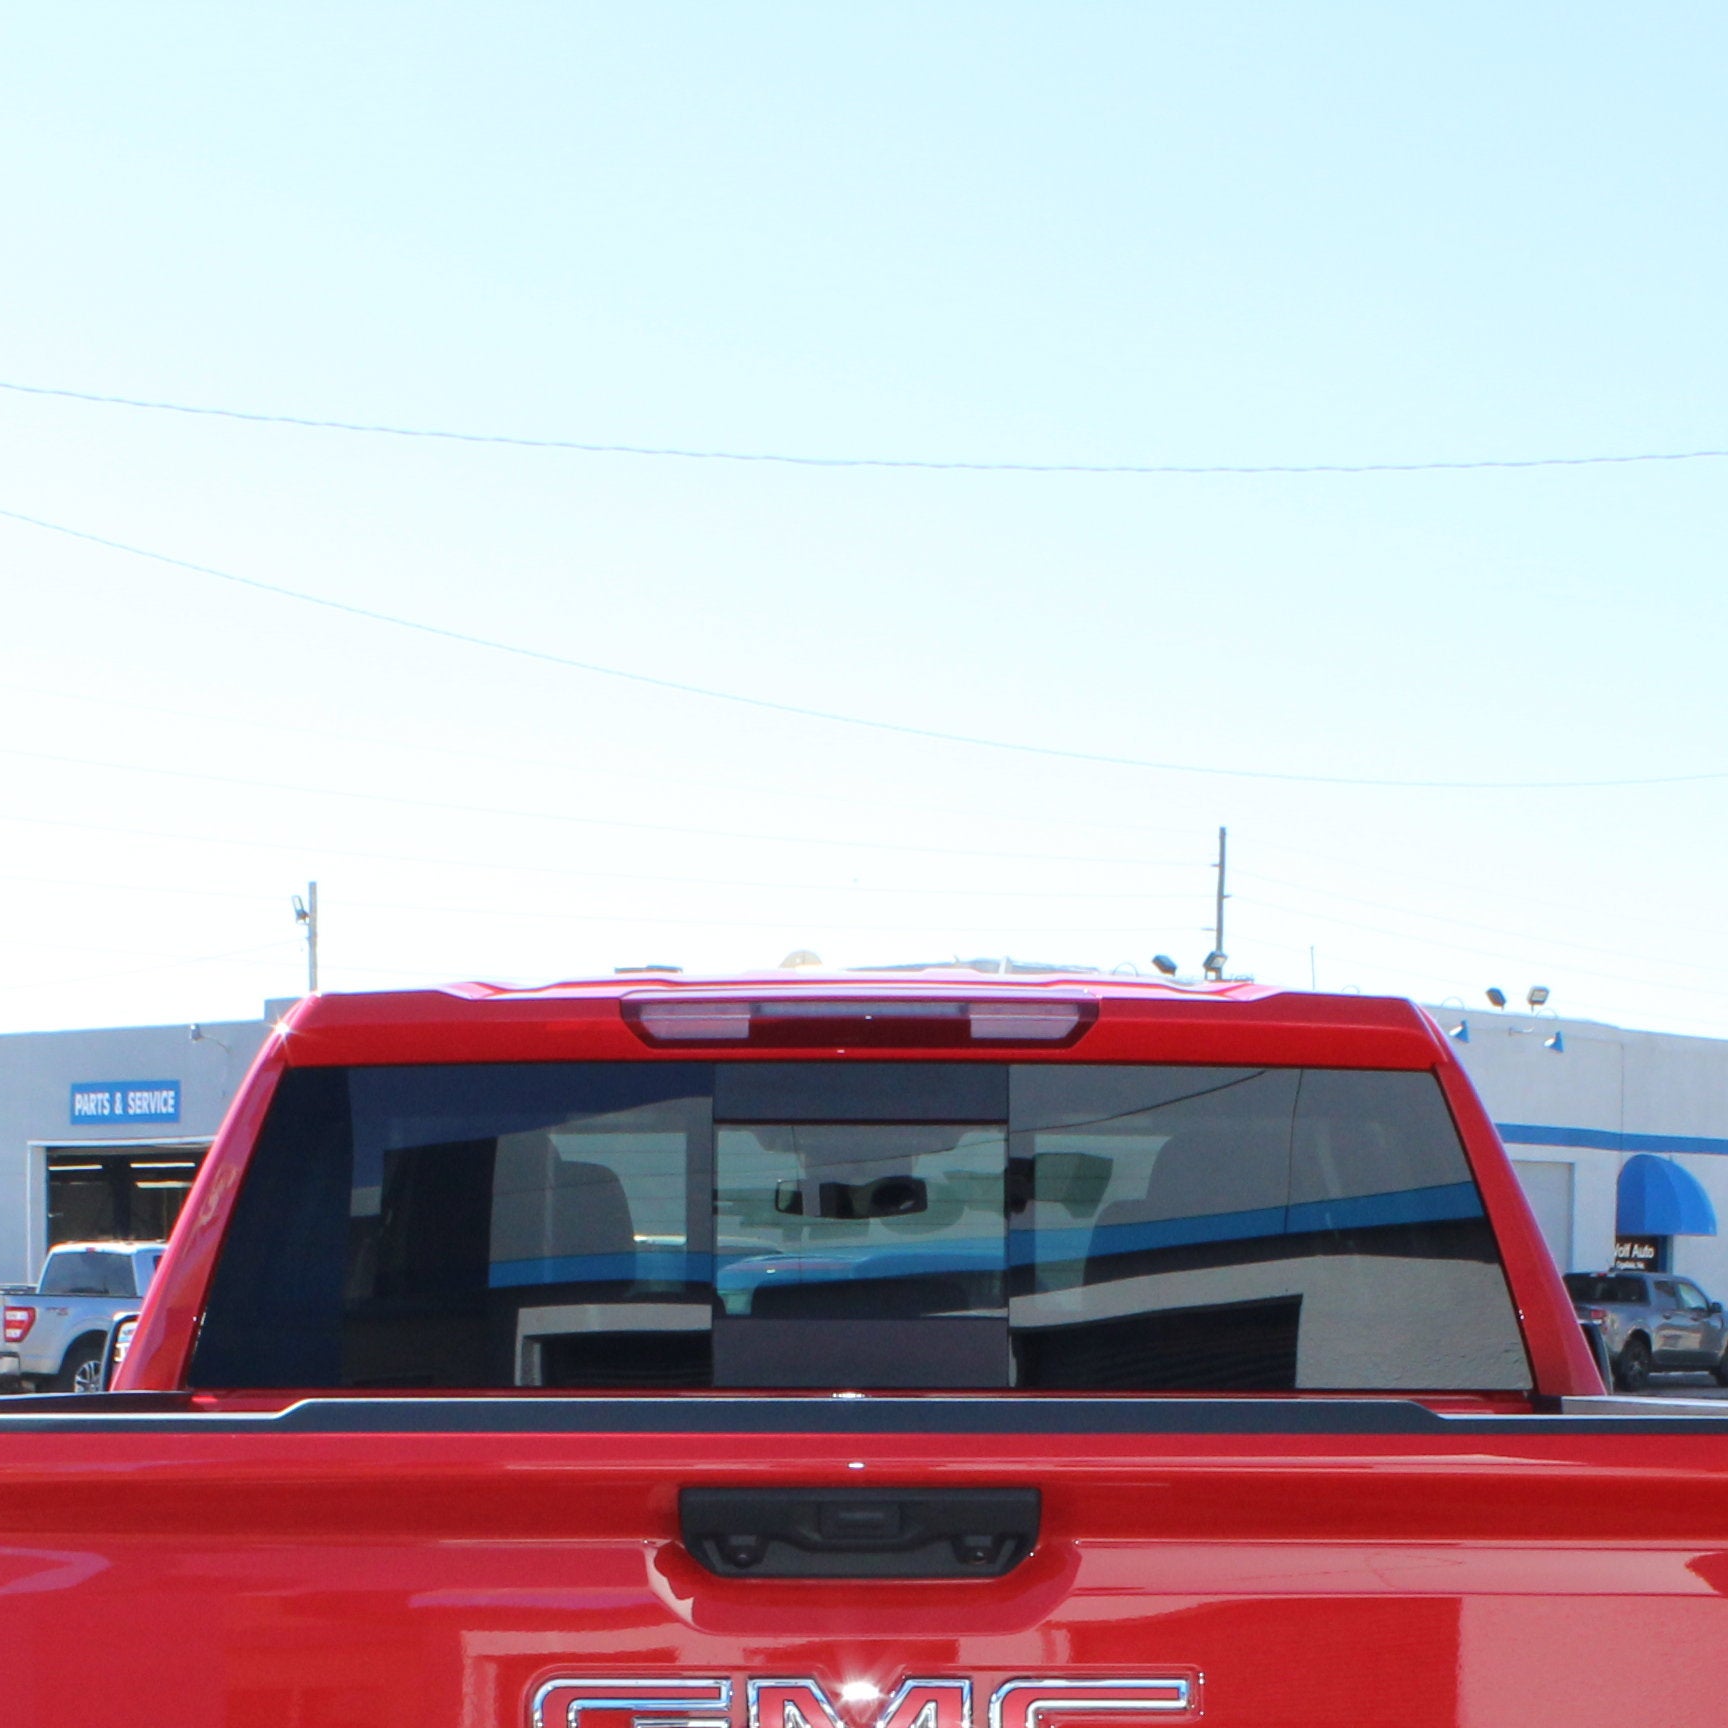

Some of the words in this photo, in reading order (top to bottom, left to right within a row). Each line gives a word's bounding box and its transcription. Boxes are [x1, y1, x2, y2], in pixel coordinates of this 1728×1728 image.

[74, 1092, 110, 1116] PARTS
[114, 1092, 123, 1115] &
[127, 1090, 176, 1115] SERVICE
[1631, 1243, 1656, 1258] Auto
